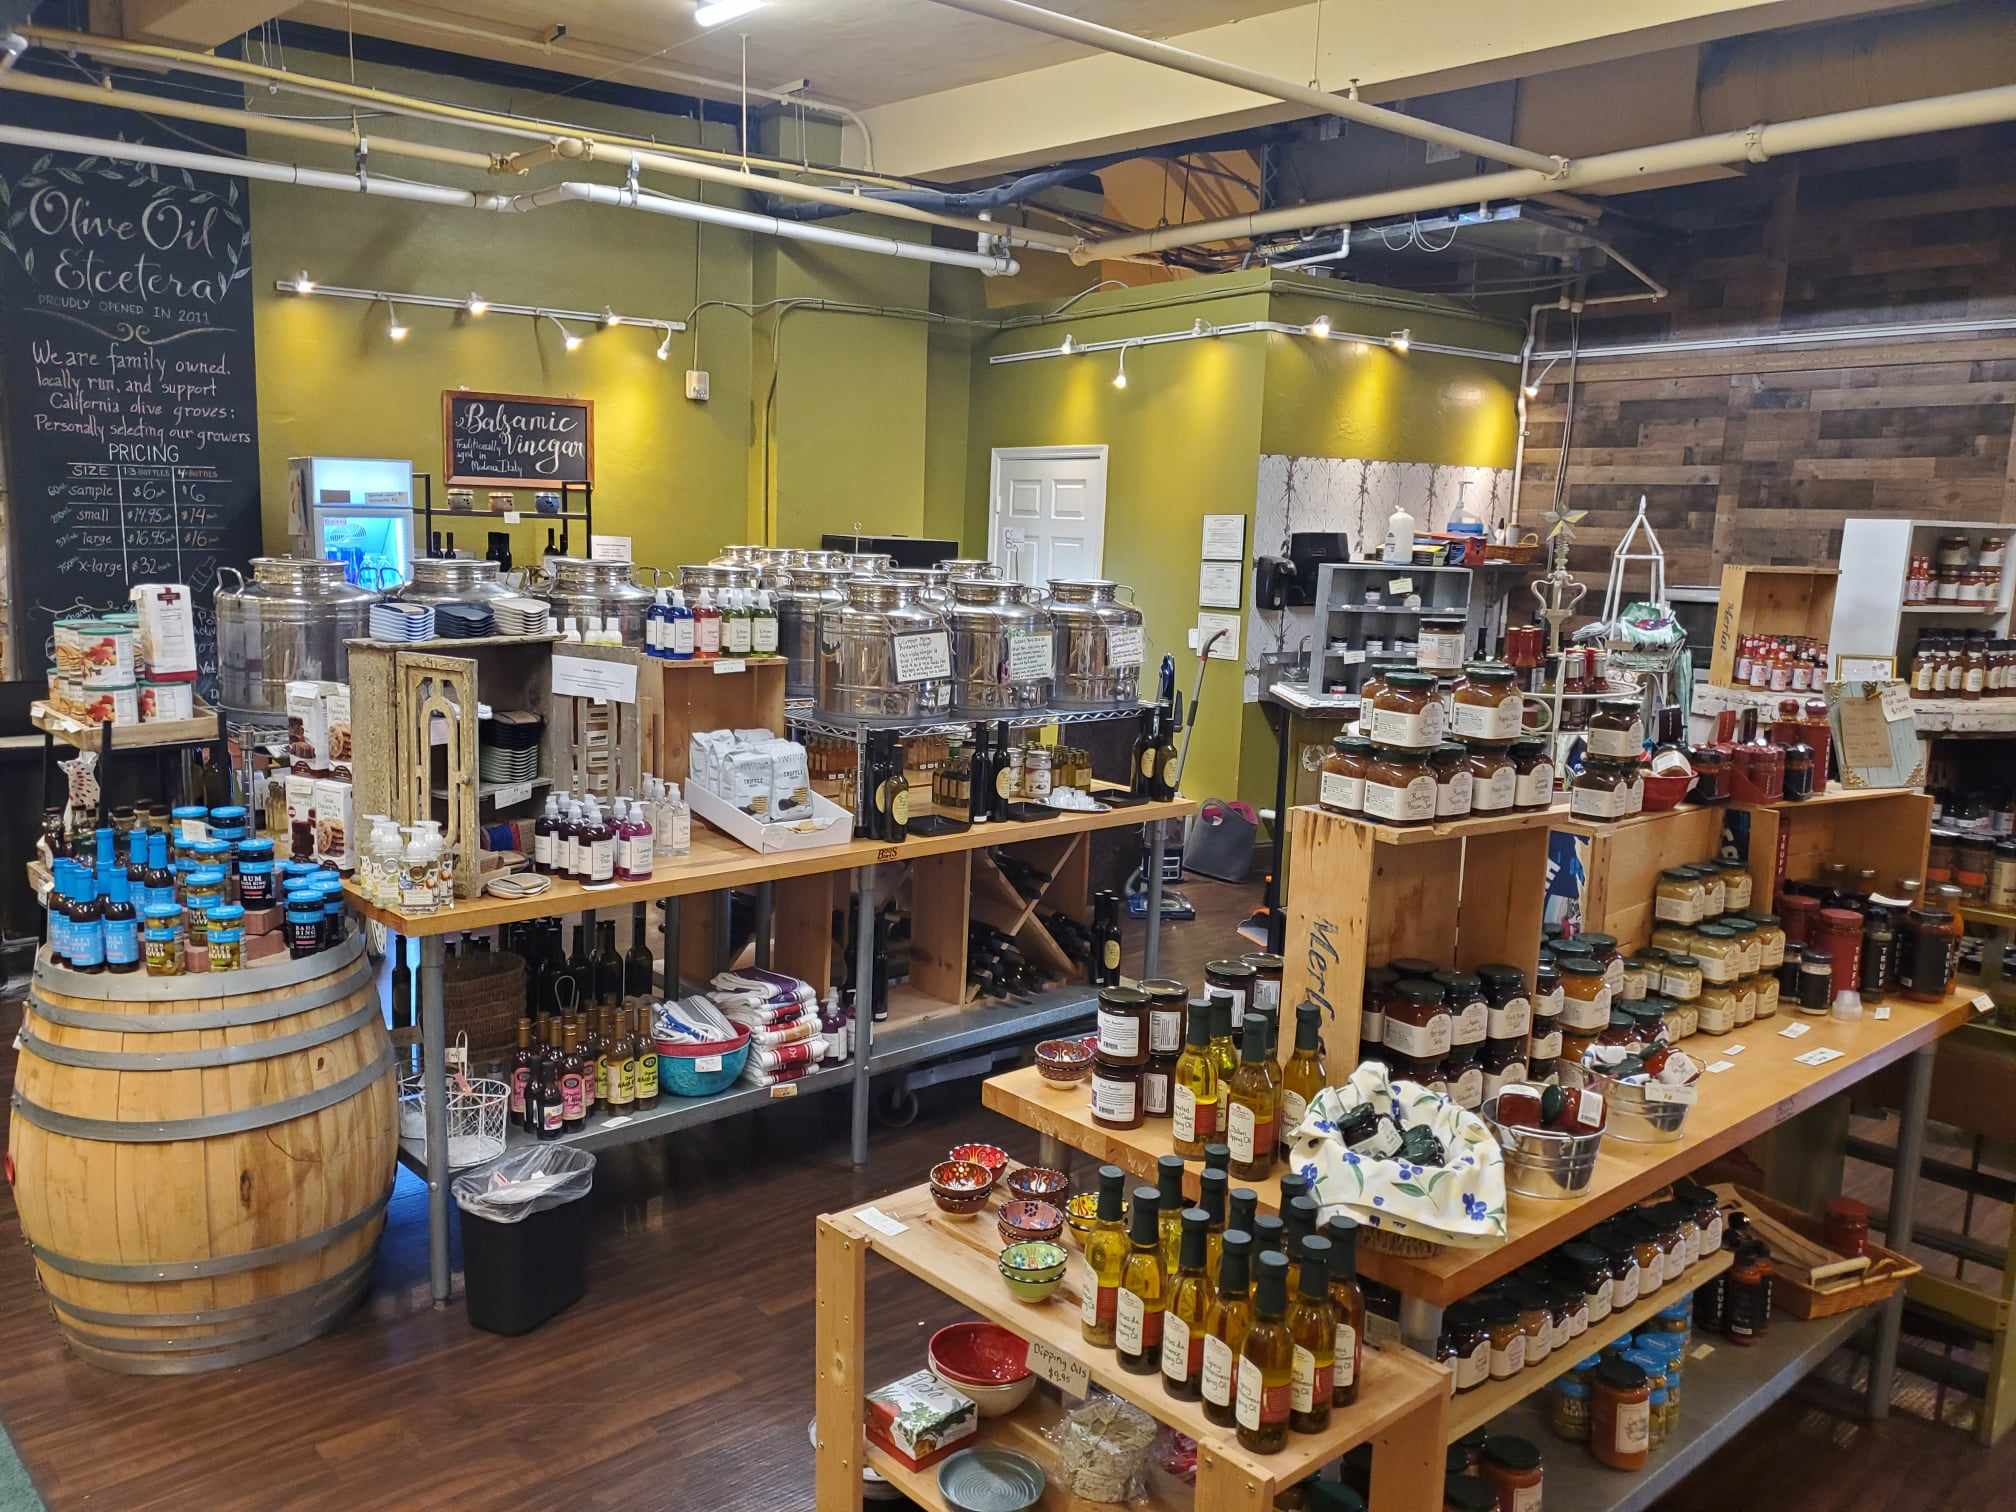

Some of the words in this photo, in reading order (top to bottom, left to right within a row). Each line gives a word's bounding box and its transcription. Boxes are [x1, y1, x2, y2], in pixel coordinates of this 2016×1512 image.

[30, 186, 137, 246] Olive
[142, 198, 219, 259] Oil
[55, 249, 217, 305] Etcetera
[38, 294, 90, 311] PROUDLY
[99, 302, 144, 315] OPENED
[152, 306, 171, 320] IN
[178, 310, 210, 324] 2011
[32, 338, 58, 366] We
[60, 350, 100, 367] are
[106, 341, 167, 383] family
[35, 367, 81, 394] locally
[125, 375, 153, 395] and
[161, 378, 218, 402] support
[49, 390, 120, 415] California
[130, 395, 163, 416] olive
[456, 402, 579, 434] Balsamic
[34, 414, 105, 445] Personally
[109, 415, 166, 447] selecting
[169, 427, 195, 440] our
[197, 427, 252, 451] growers
[455, 438, 502, 457] Traditionally
[108, 443, 180, 463] PRICING
[479, 452, 488, 460] in
[499, 432, 586, 474] Vinegar
[71, 464, 109, 477] SIZE
[497, 459, 523, 478] Italy
[68, 483, 114, 501] sample
[76, 506, 109, 522] small
[82, 531, 113, 547] large
[1305, 913, 1340, 1022] Merl
[1716, 1279, 1725, 1319] TRUFF
[1033, 1343, 1068, 1371] Dipping
[1070, 1363, 1088, 1379] Oils
[1048, 1367, 1072, 1384] $9.95
